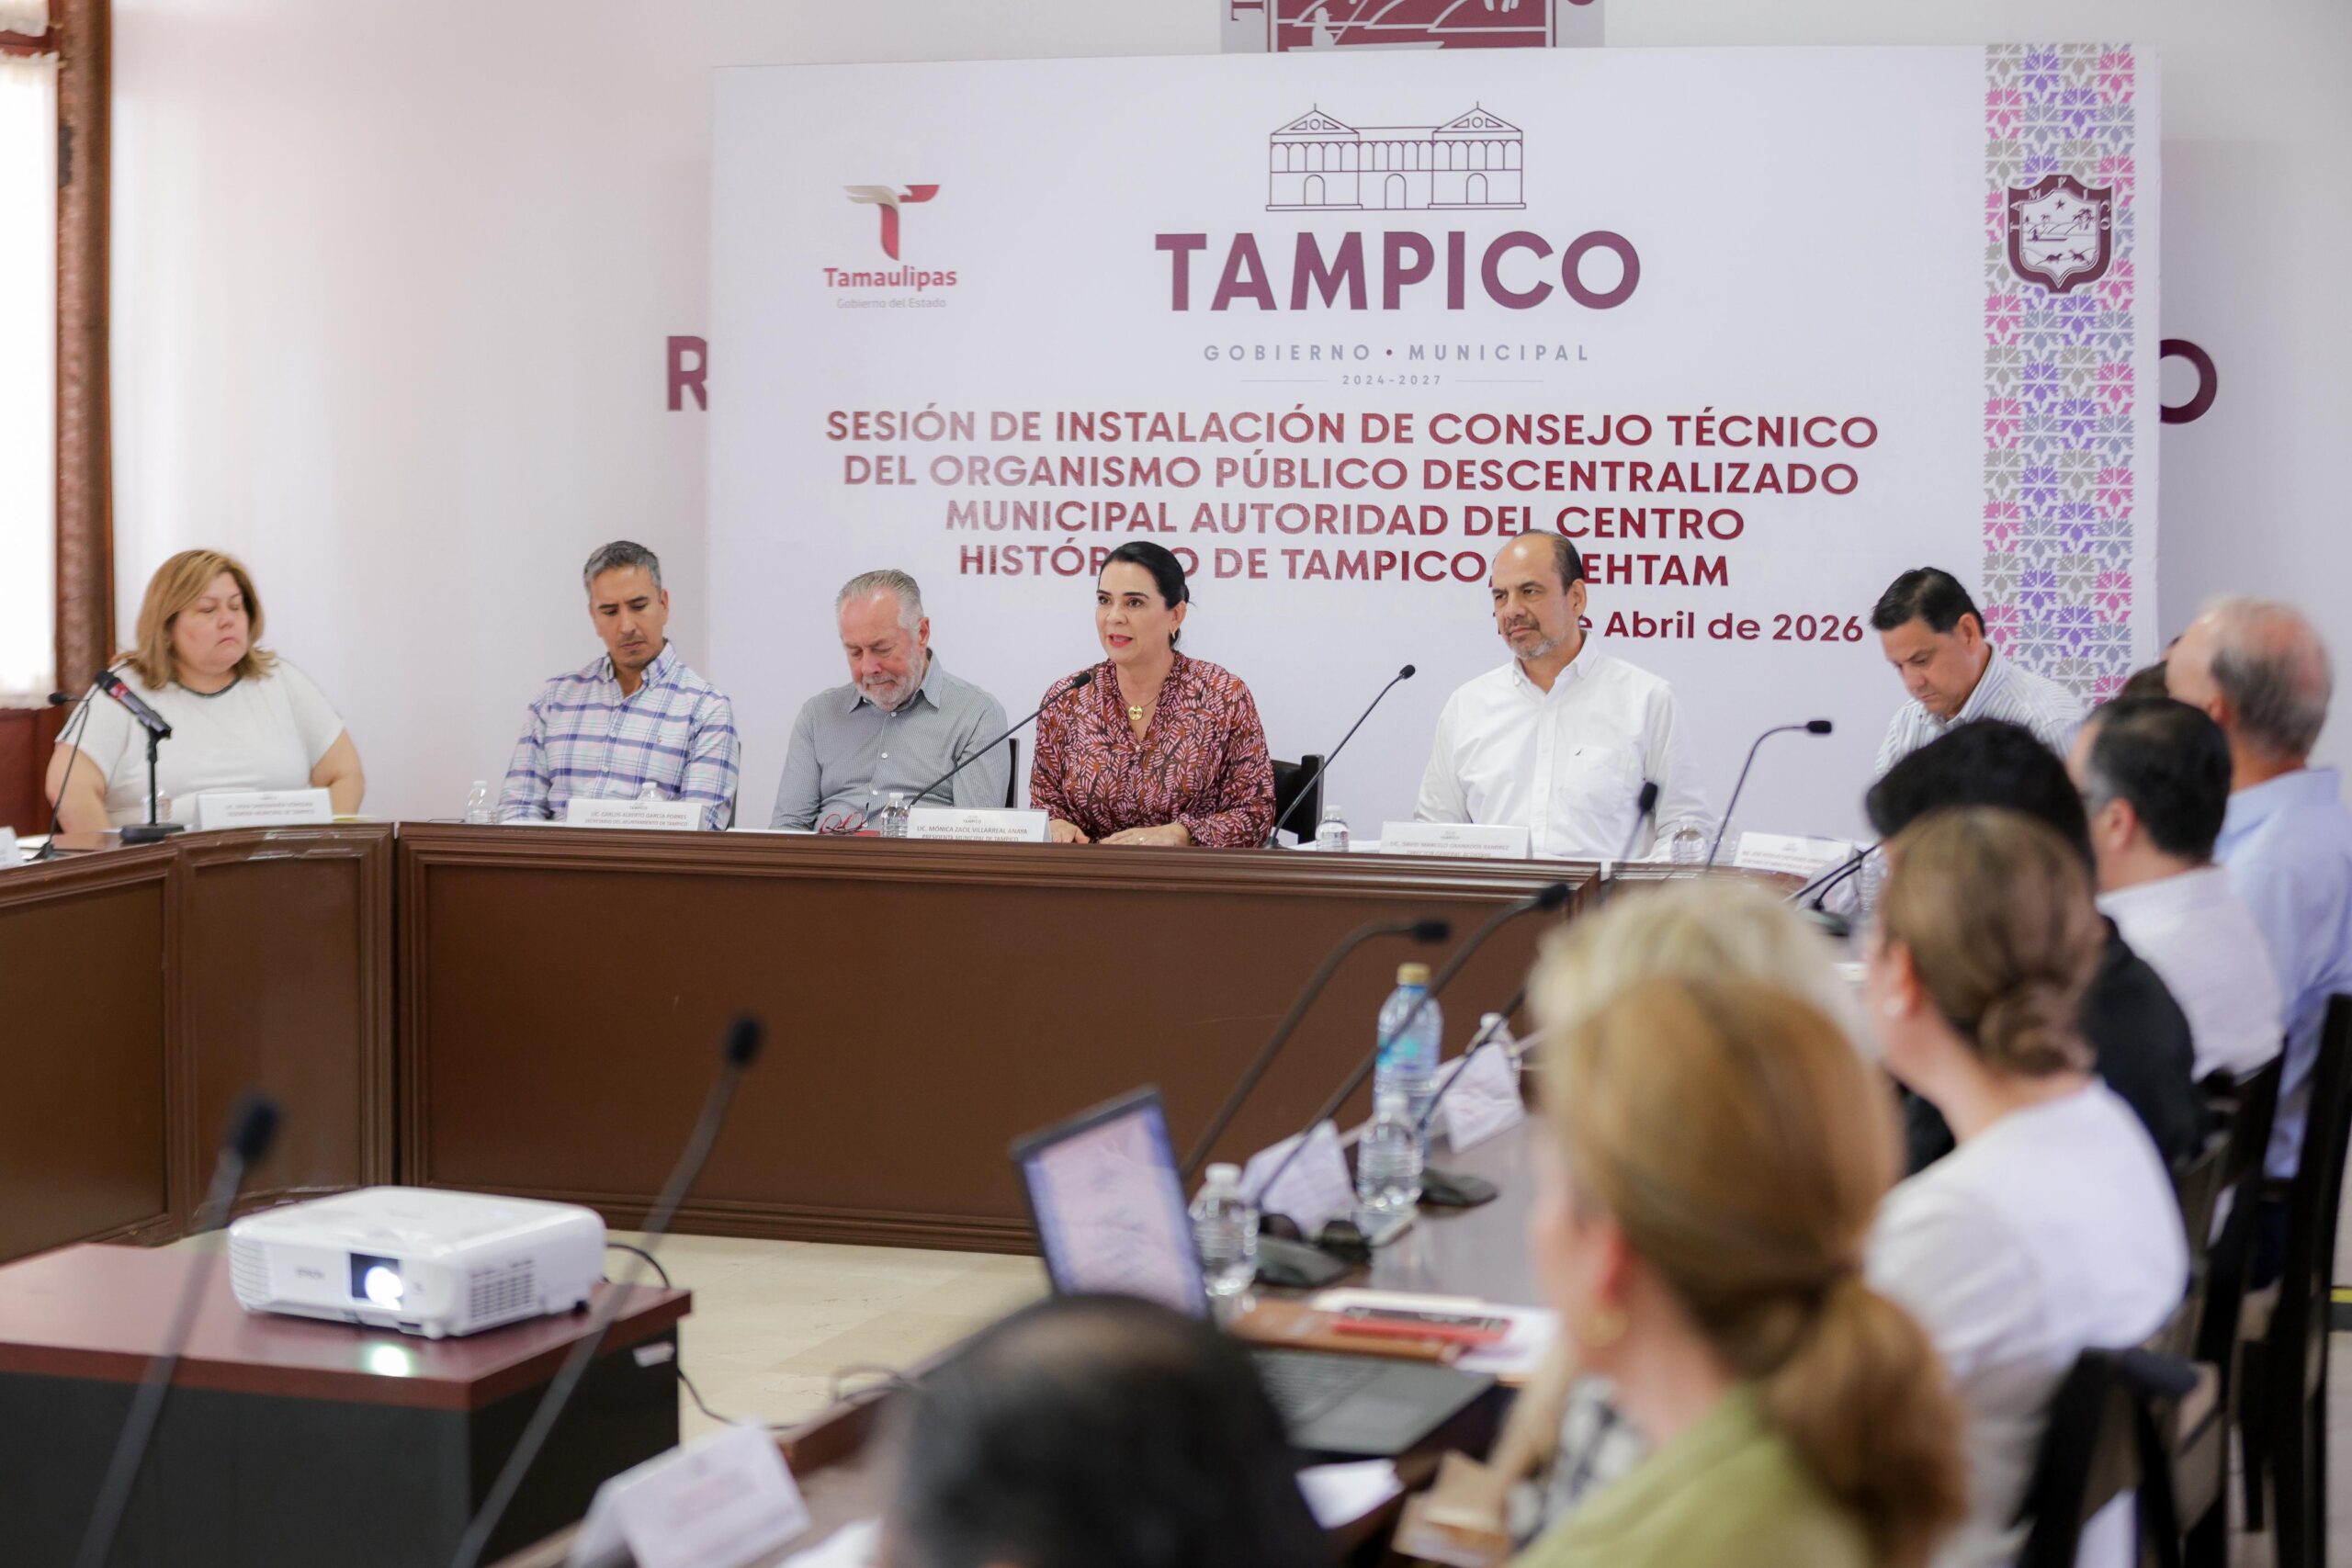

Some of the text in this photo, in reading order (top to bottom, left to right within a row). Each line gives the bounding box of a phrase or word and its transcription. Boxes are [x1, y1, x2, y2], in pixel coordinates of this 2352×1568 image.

[822, 265, 957, 291] Tamaulipas
[1155, 230, 1641, 311] TAMPICO
[836, 298, 946, 309] Gobierno del Estado
[1204, 344, 1589, 362] GOBIERNO MUNICIPAL
[1342, 374, 1442, 386] 2024-2027
[825, 403, 1879, 449] SESIÓN DE INSTALACIÓN DE CONSEJO TÉCNICO
[843, 449, 1859, 496] DEL ORGANISMO PÚBLICO DESCENTRALIZADO
[946, 500, 1178, 534] MUNICIPAL
[1189, 502, 1449, 536] AUTORIDAD
[1556, 506, 1745, 541] CENTRO
[959, 536, 1200, 578] HISTÓRO
[1214, 547, 1268, 580] DE
[1603, 610, 1695, 639] Abril
[1707, 612, 1761, 641] de
[1771, 613, 1864, 643] 2026
